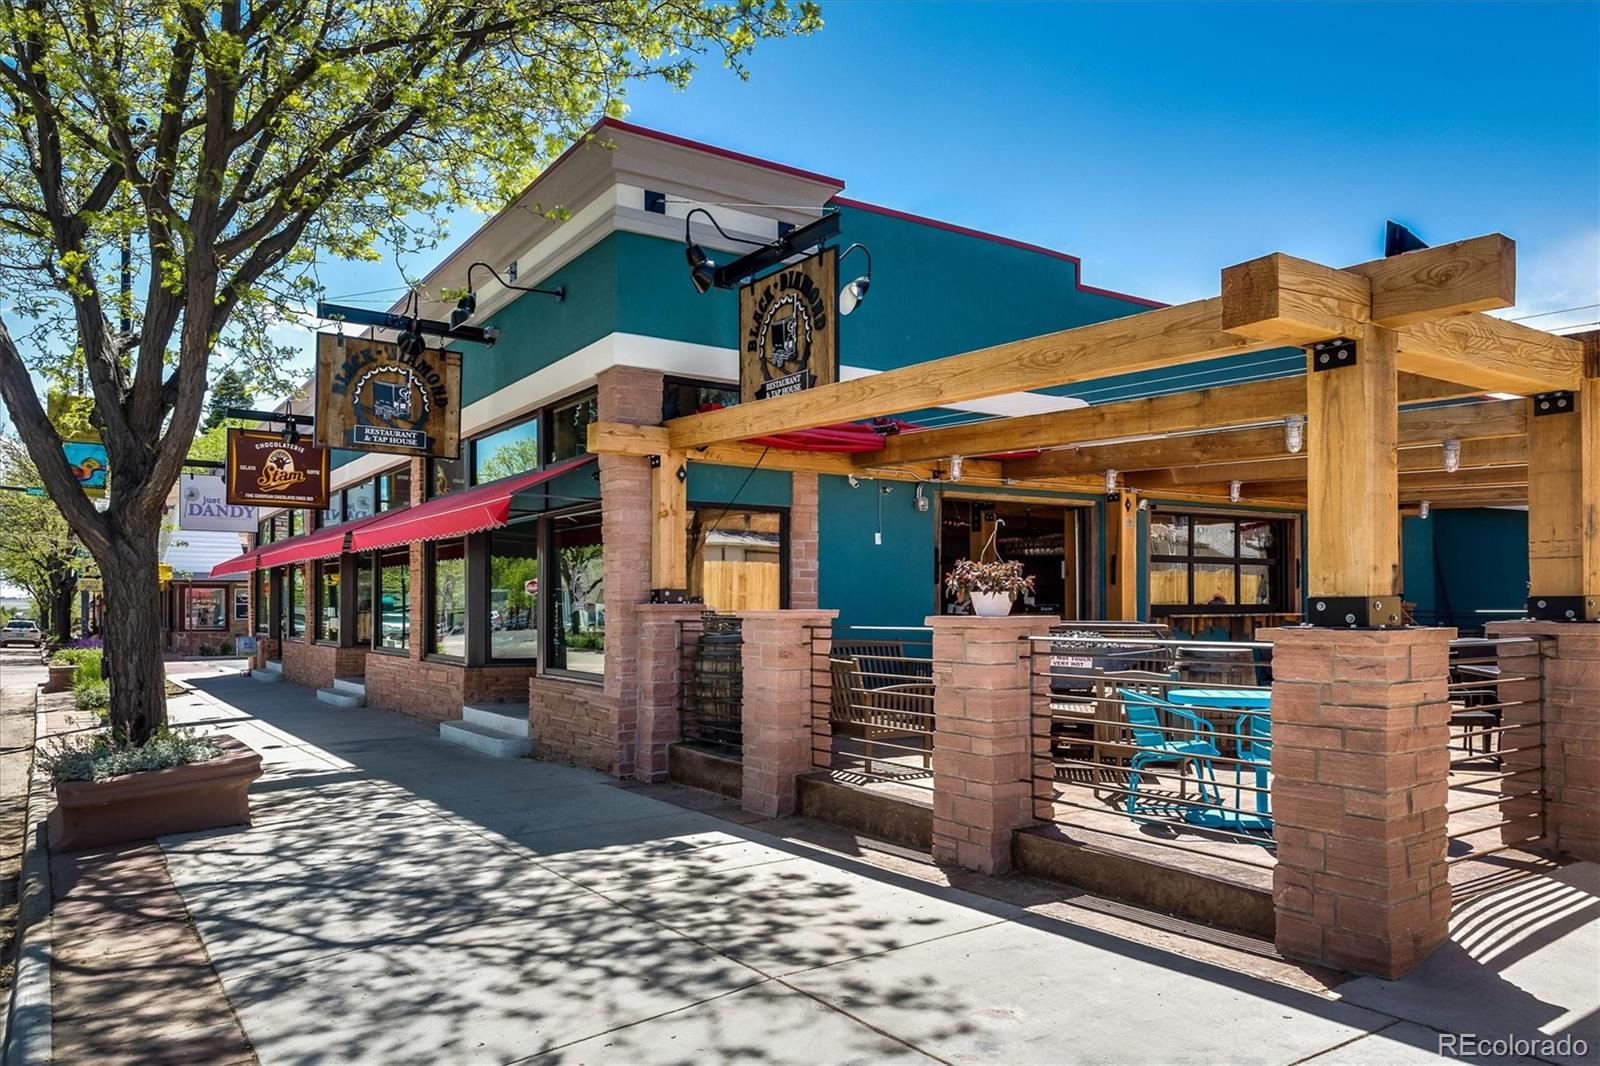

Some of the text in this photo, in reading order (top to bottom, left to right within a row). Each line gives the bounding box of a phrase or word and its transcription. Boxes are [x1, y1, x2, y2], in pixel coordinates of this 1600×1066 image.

[747, 271, 826, 352] BLACK DIAMOND
[332, 348, 377, 395] BLACK
[765, 374, 802, 391] RESTAURANT
[781, 383, 802, 396] HOUSE
[364, 427, 418, 439] RESTAURANT
[255, 441, 306, 454] CHOCOLATERIE
[372, 435, 388, 443] TAP
[389, 437, 418, 446] HOUSE
[257, 465, 305, 486] Stam
[202, 496, 220, 505] just
[188, 503, 256, 518] DANDY
